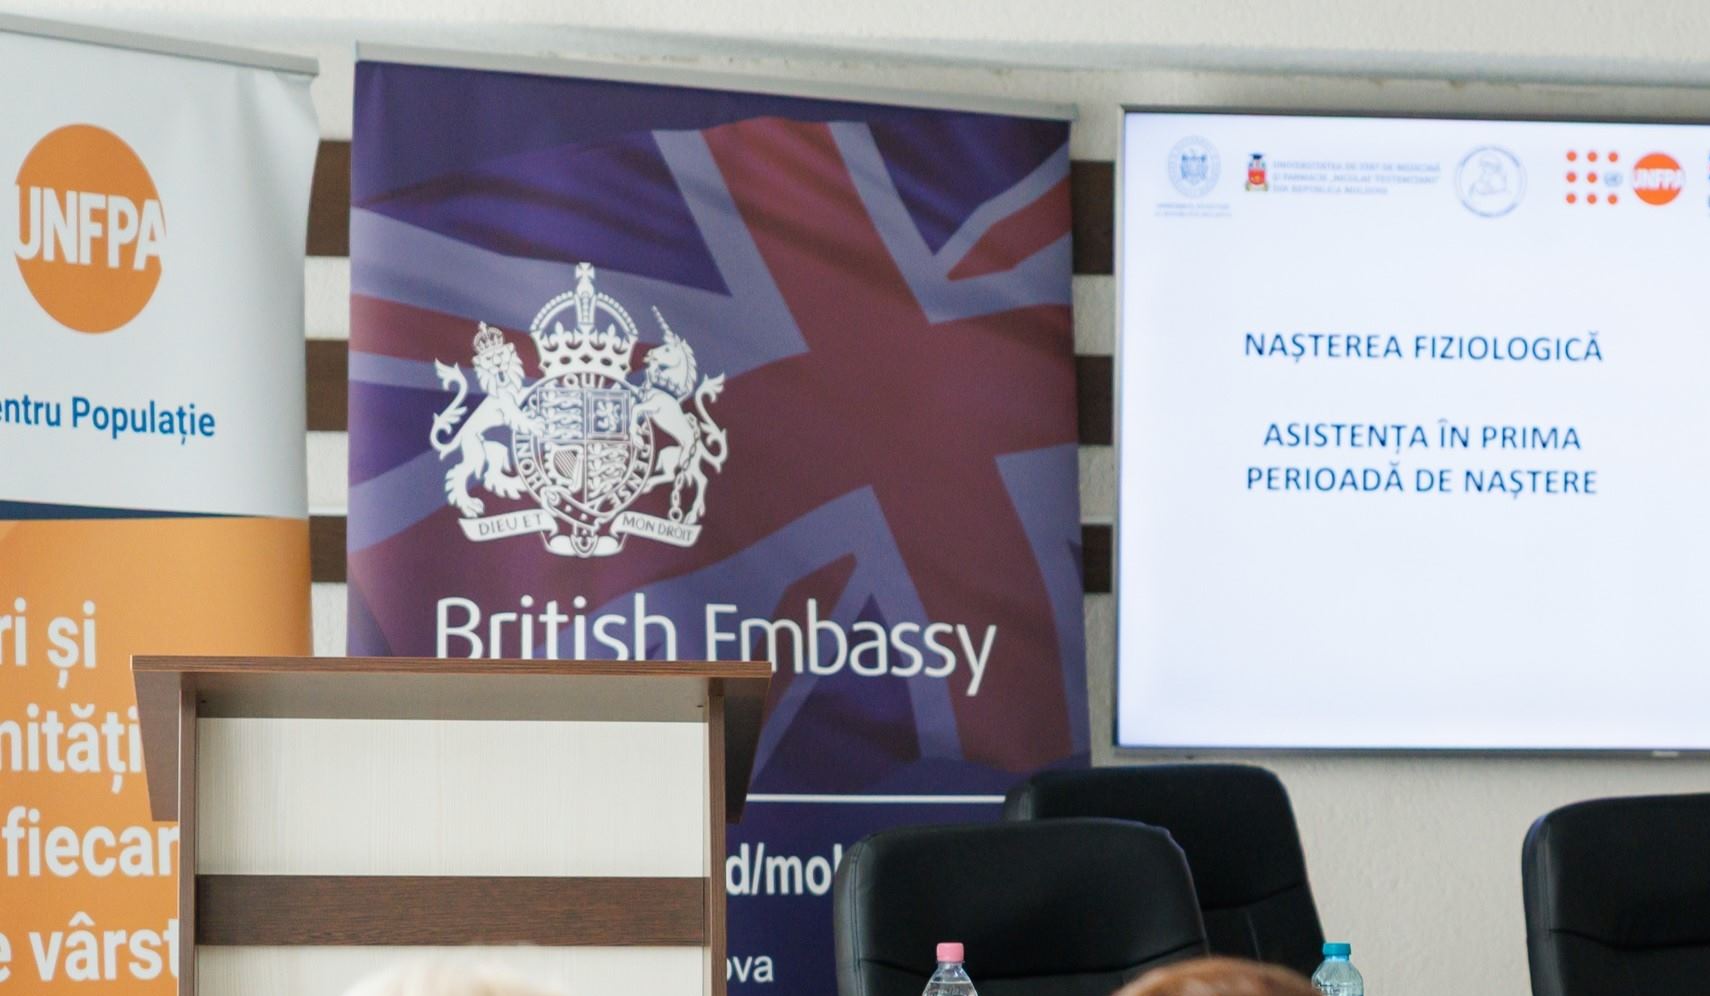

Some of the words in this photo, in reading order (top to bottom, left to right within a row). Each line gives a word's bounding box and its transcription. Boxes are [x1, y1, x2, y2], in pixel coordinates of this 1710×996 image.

[15, 184, 166, 272] UNFPA
[1245, 332, 1402, 363] NAȘTEREA
[1414, 330, 1602, 362] FIZIOLOGICĂ
[72, 396, 215, 445] Populație
[1263, 422, 1429, 454] ASISTENȚA
[1437, 418, 1470, 449] ÎN
[1481, 425, 1582, 450] PRIMA
[1247, 460, 1404, 492] PERIOADĂ
[1415, 468, 1453, 493] DE
[1464, 469, 1599, 500] NAȘTERE
[478, 515, 518, 536] DIEU
[523, 513, 542, 529] ET
[622, 514, 657, 533] MON
[48, 600, 97, 689] și
[437, 593, 677, 660] British
[706, 598, 996, 696] Embassy
